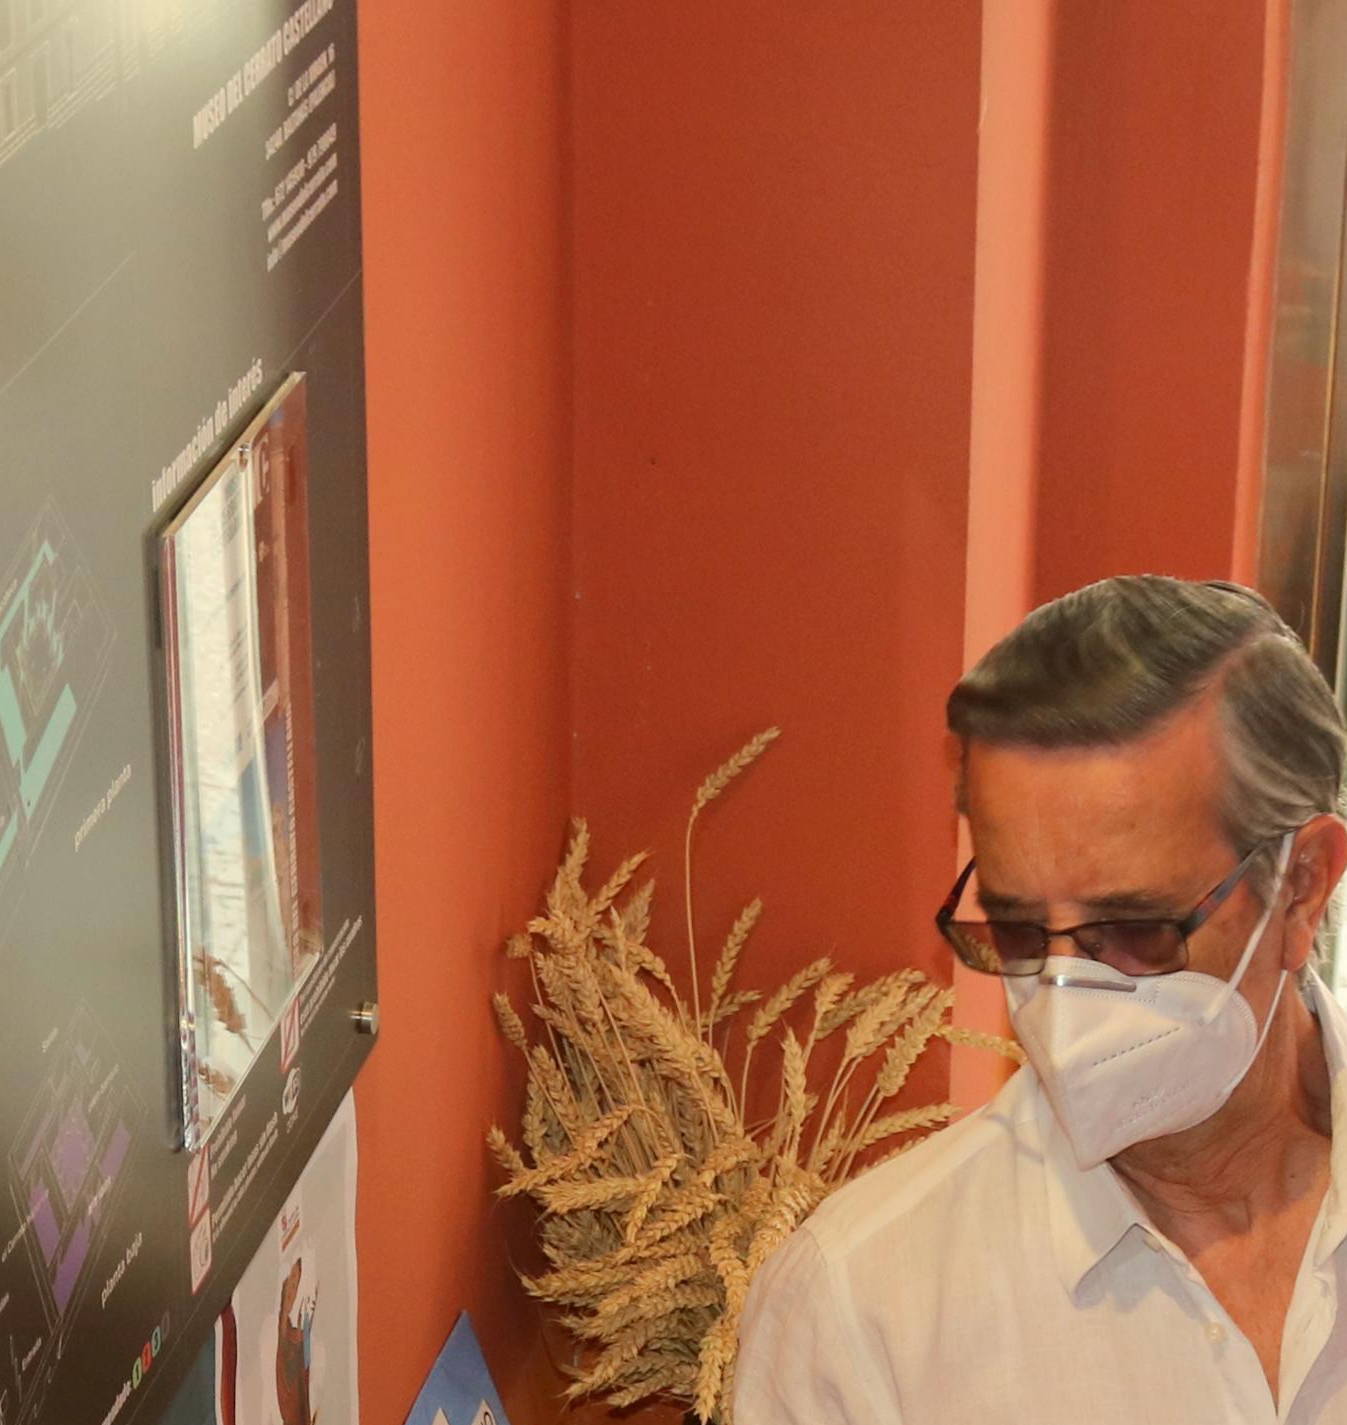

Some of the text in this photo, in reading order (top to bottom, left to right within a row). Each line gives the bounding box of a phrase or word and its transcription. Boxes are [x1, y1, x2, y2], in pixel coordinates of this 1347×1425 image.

[193, 86, 226, 149] MUSEO
[226, 69, 244, 114] DEL
[243, 28, 283, 97] CERRATO
[151, 414, 214, 513] información
[214, 398, 228, 435] de
[228, 356, 264, 420] interés
[74, 763, 132, 852] primera planta
[102, 1232, 142, 1310] planta baja
